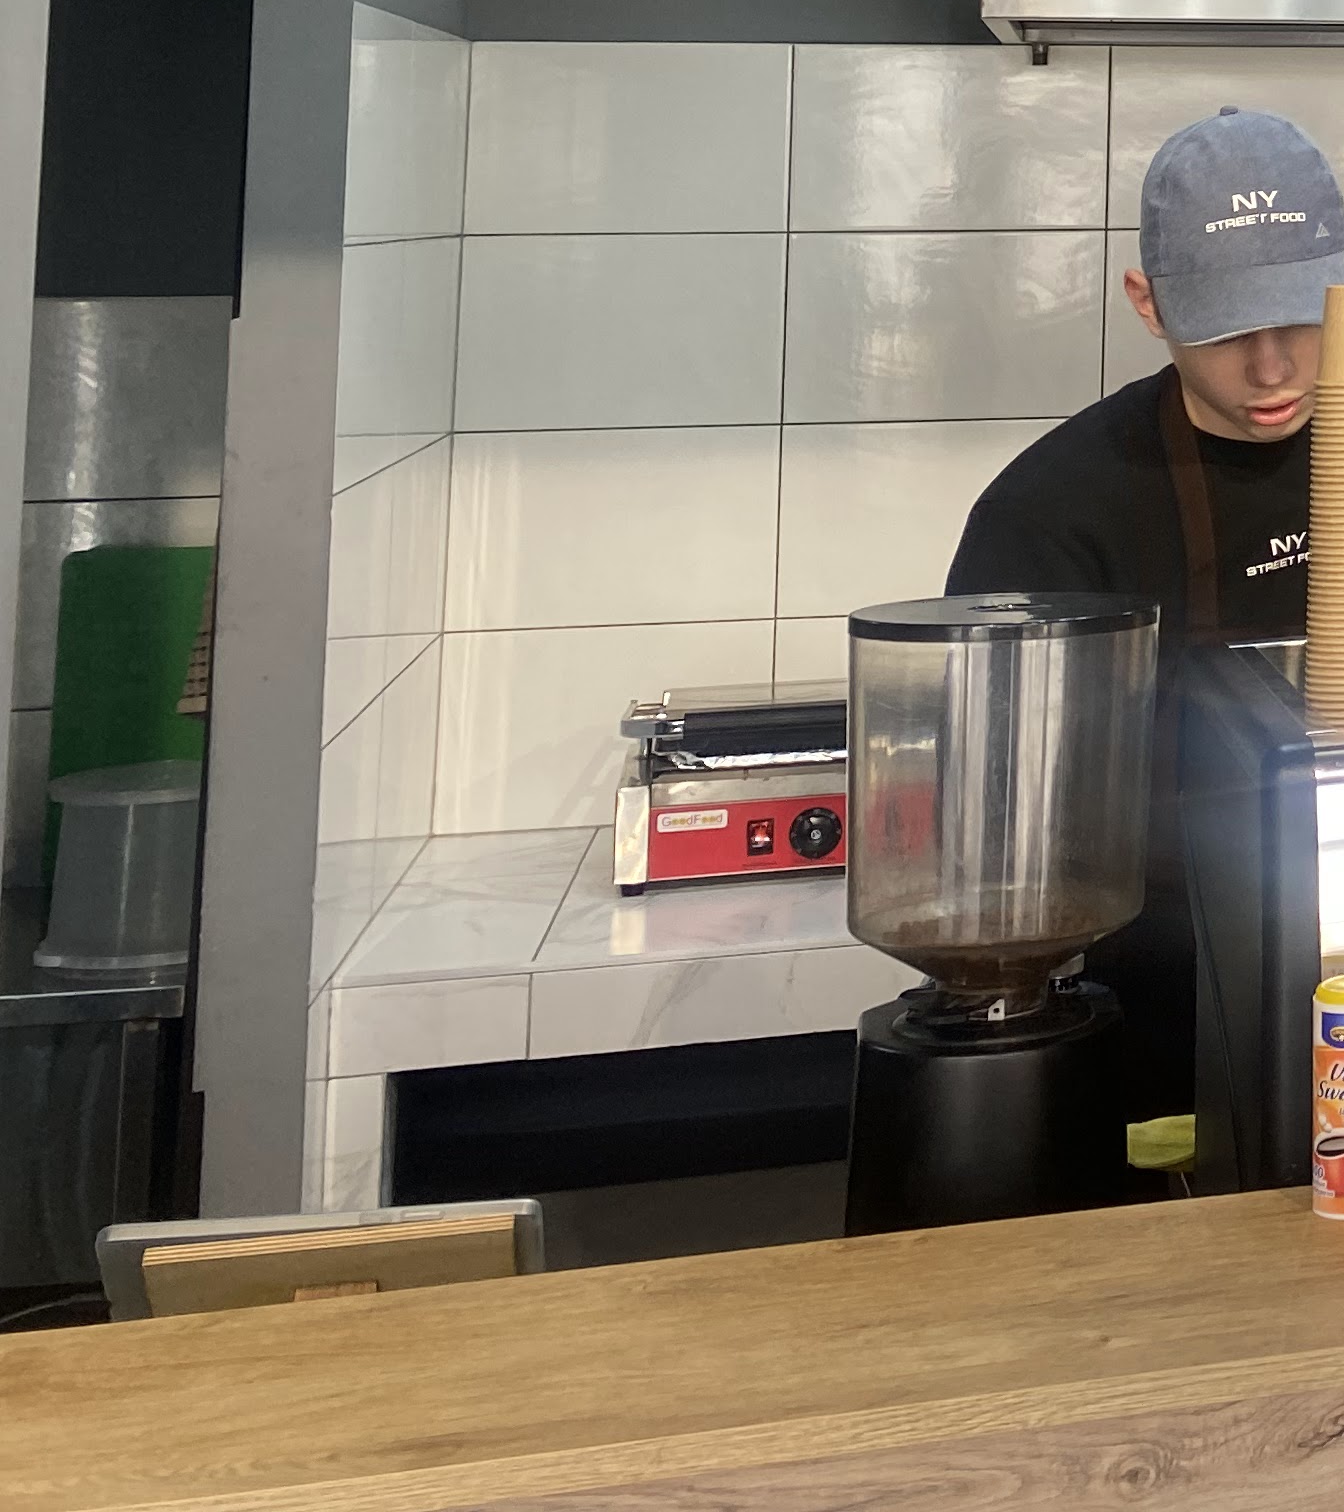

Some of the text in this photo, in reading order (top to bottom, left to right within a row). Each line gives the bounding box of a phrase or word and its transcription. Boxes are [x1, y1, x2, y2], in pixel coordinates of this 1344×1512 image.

[1231, 190, 1279, 213] NY
[1205, 212, 1307, 233] STREET FOOD
[1269, 531, 1307, 556] NY
[1245, 555, 1296, 577] STREET
[661, 813, 723, 828] GoodFood
